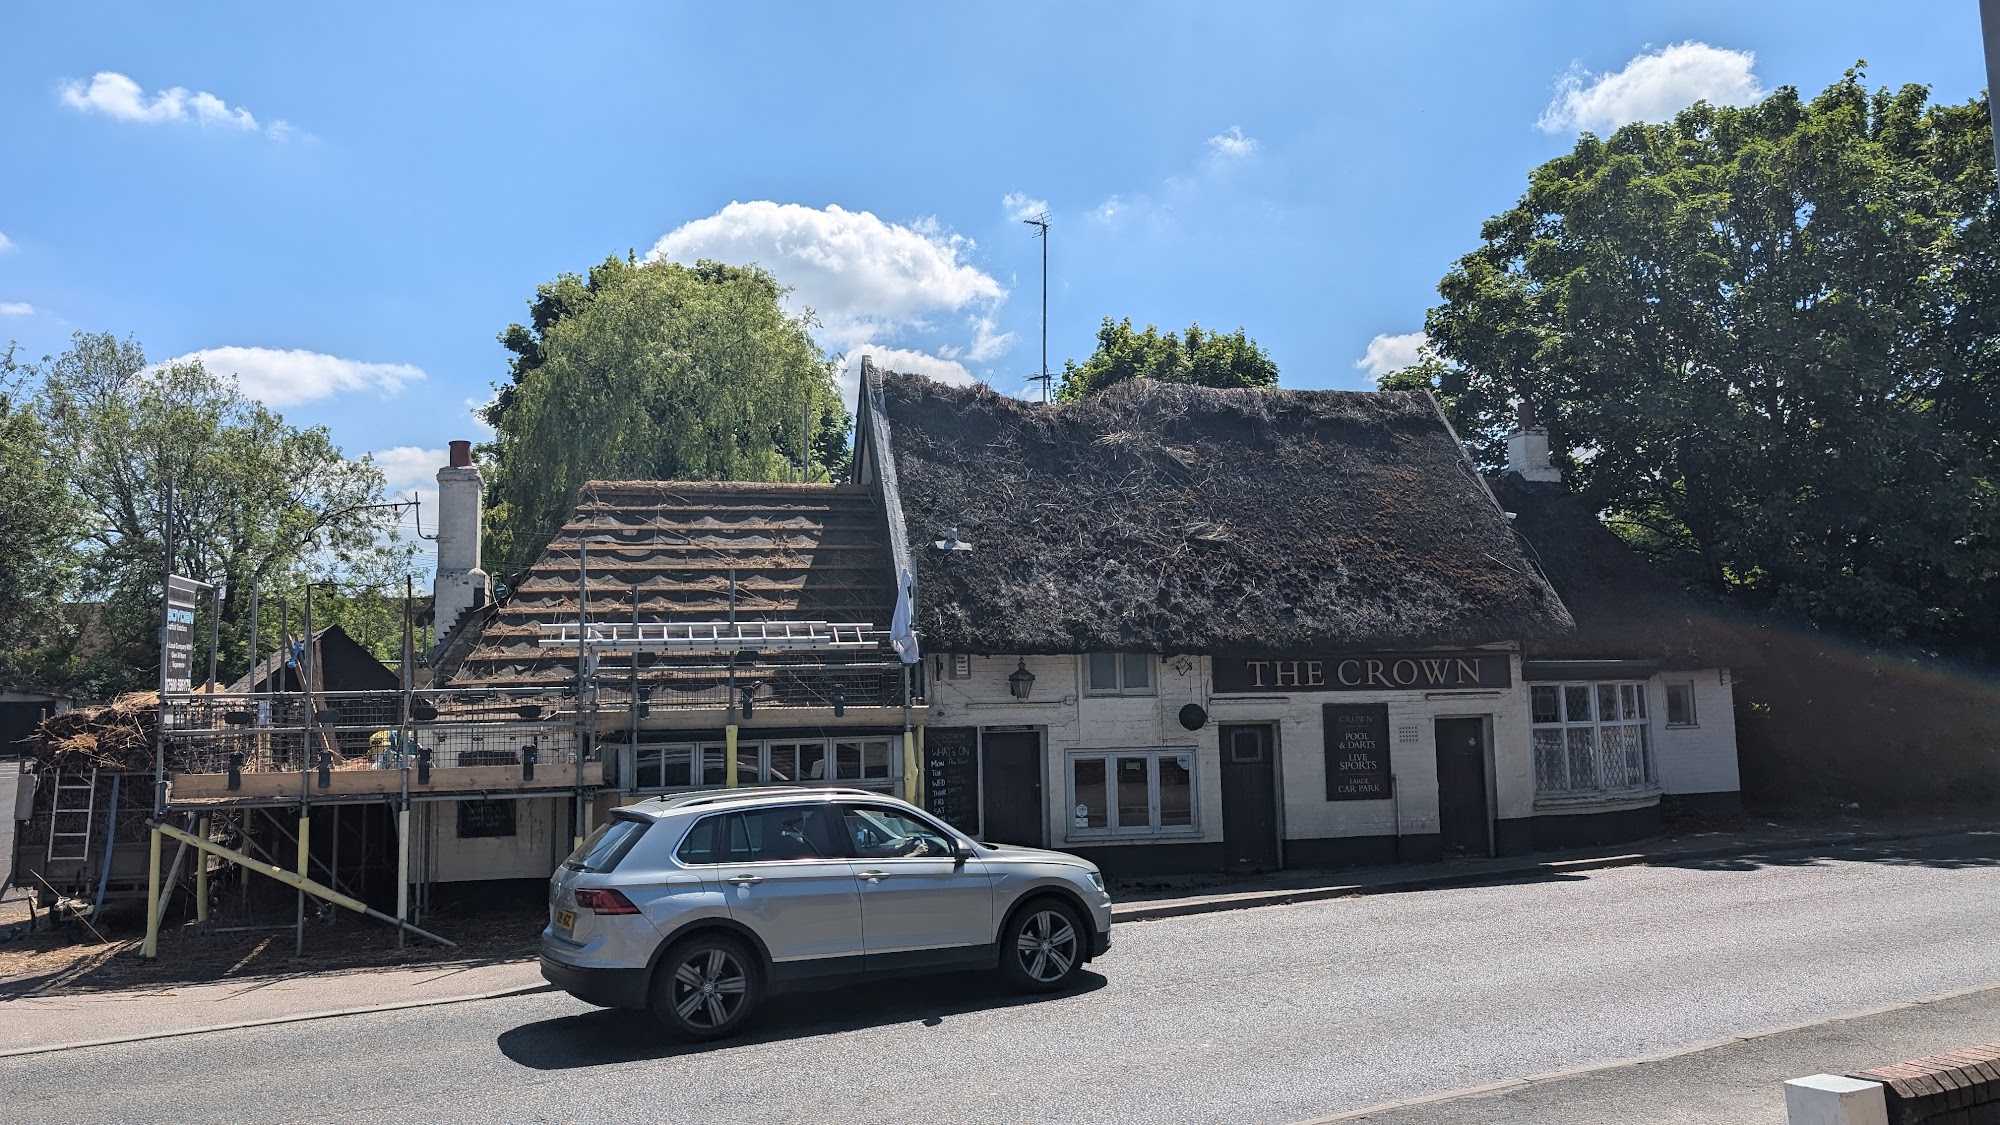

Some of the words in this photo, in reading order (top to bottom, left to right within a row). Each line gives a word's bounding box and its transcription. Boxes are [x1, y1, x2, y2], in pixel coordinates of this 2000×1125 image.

[1246, 660, 1326, 687] THE
[1337, 658, 1482, 688] CROWN
[1339, 715, 1374, 724] CROWN
[1345, 732, 1370, 741] POOL
[1339, 741, 1346, 750] &
[1347, 740, 1377, 749] DARTS
[958, 745, 970, 756] ON
[1348, 753, 1369, 762] LIVE
[1339, 760, 1378, 771] SPORTS
[931, 778, 946, 787] WED
[1338, 785, 1357, 793] CAR
[1358, 784, 1381, 792] PARK
[933, 798, 945, 806] FRI
[933, 806, 945, 815] SAT
